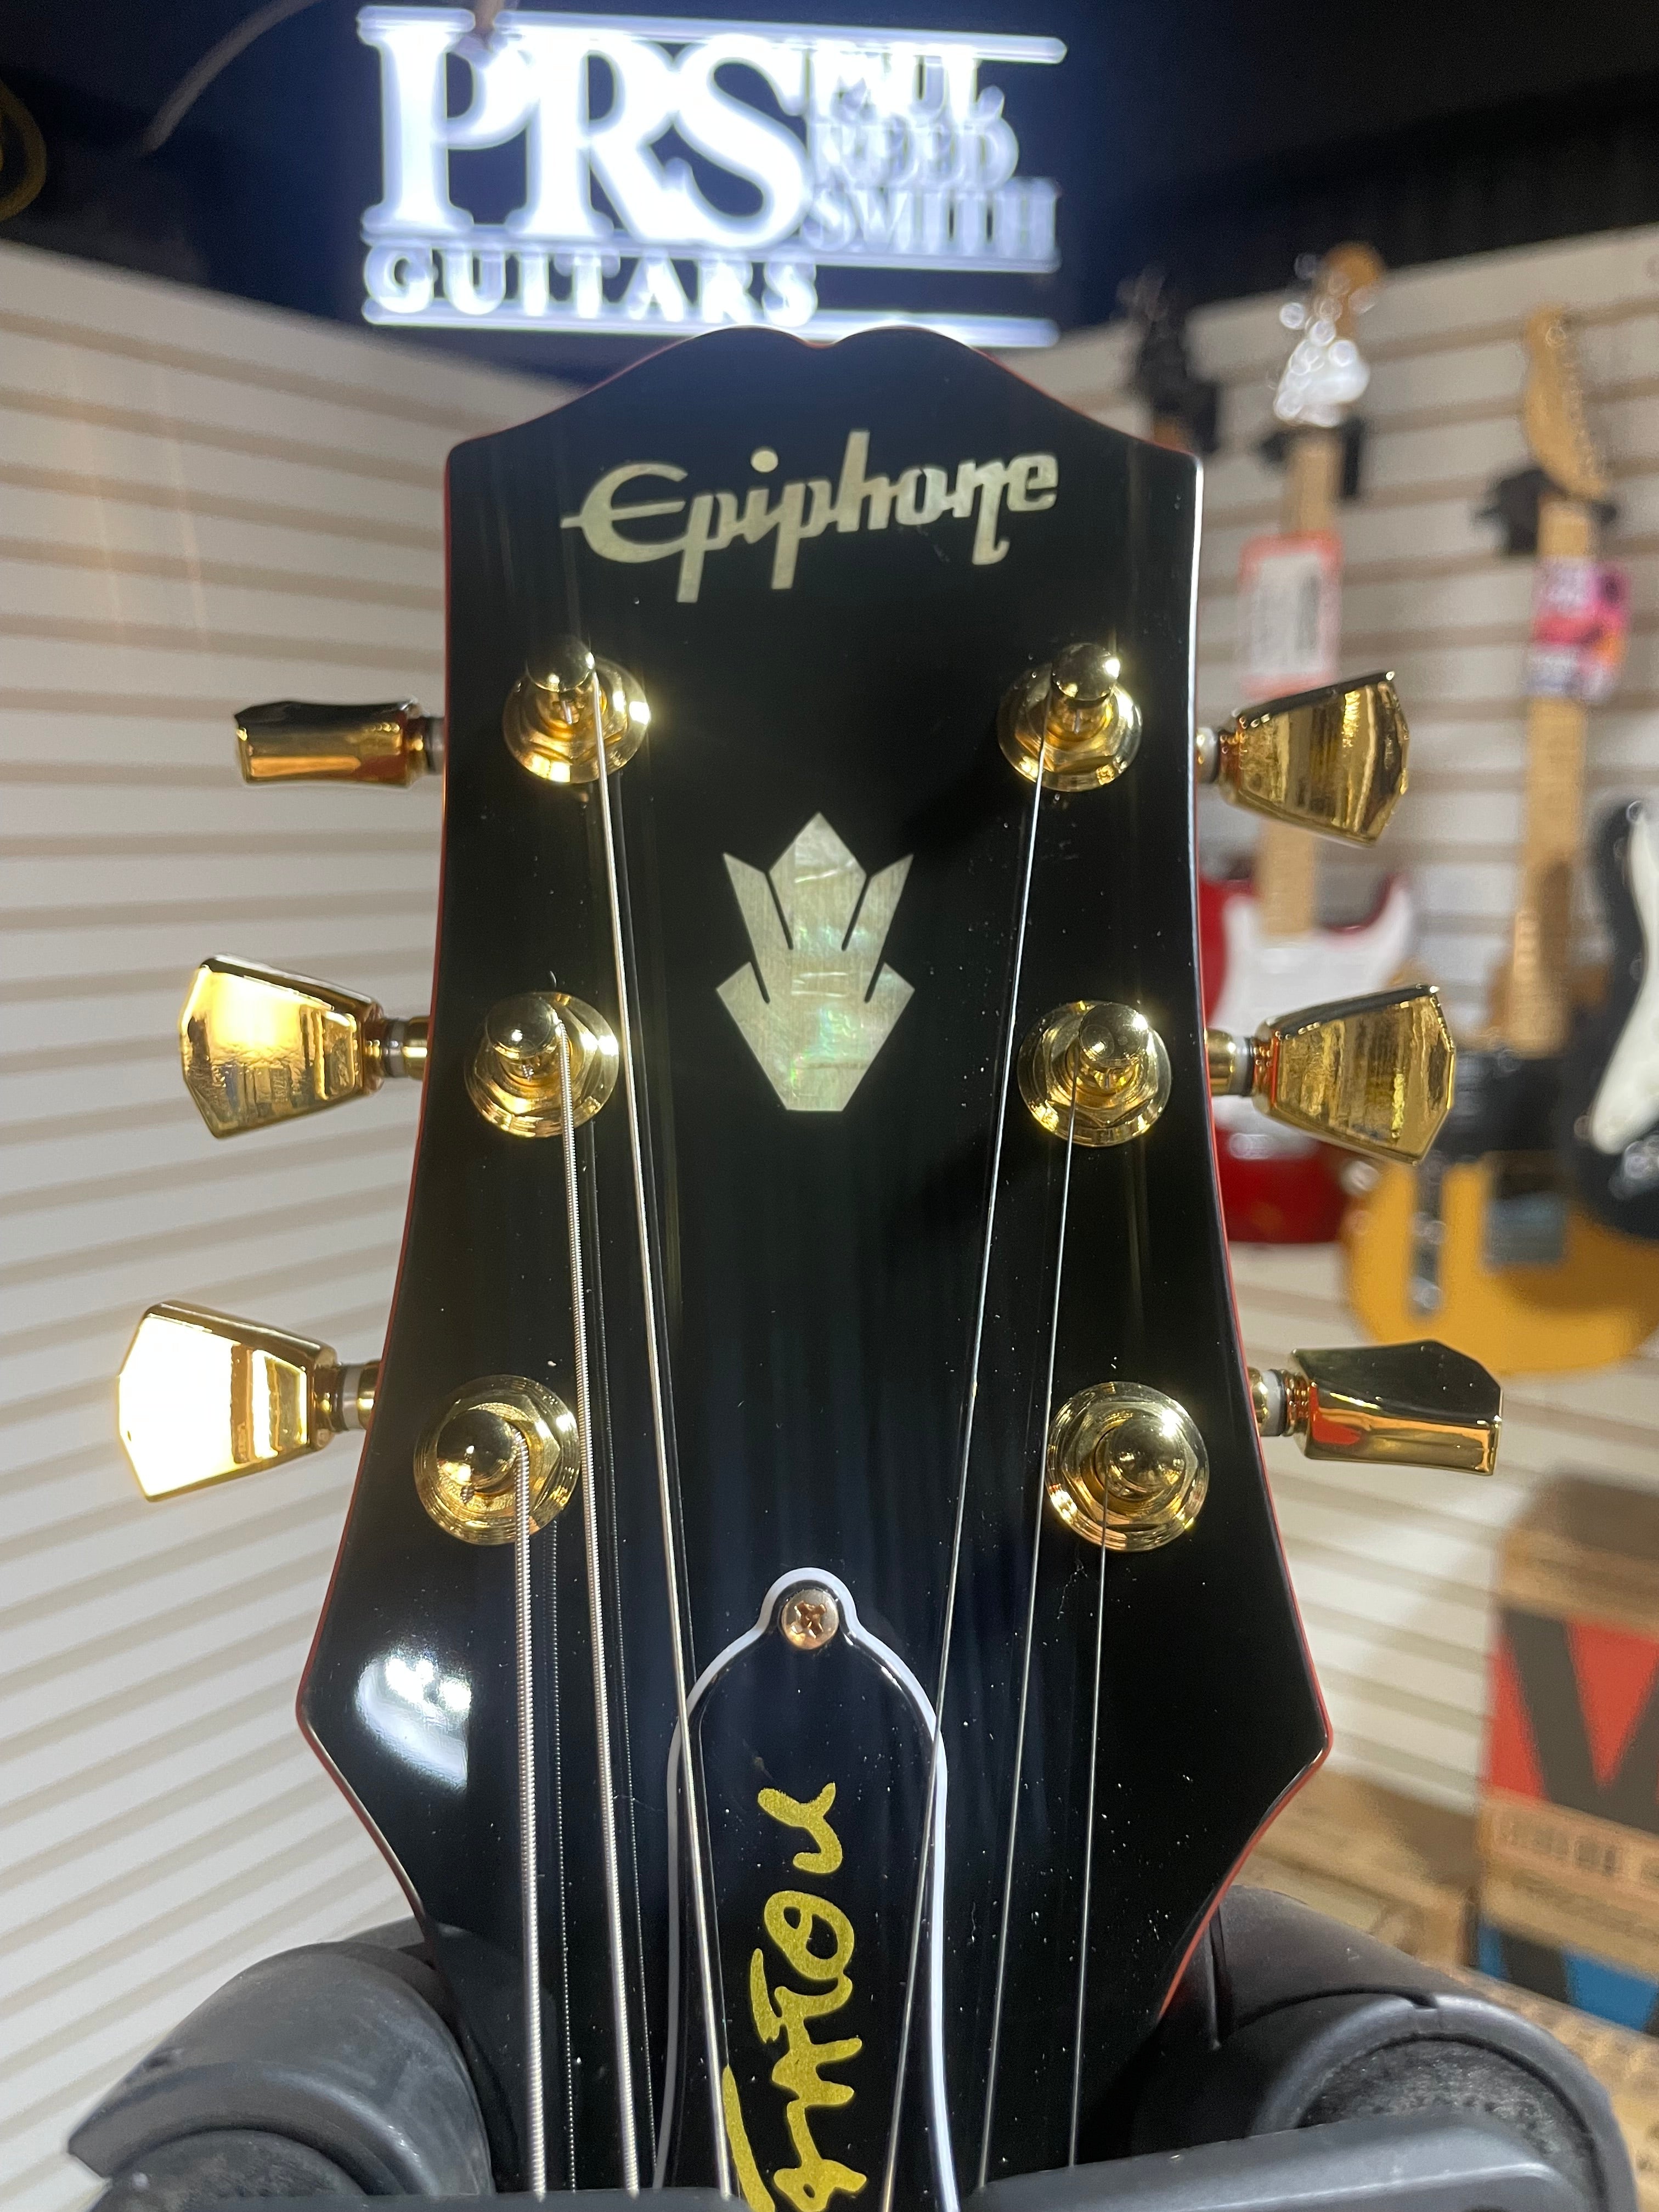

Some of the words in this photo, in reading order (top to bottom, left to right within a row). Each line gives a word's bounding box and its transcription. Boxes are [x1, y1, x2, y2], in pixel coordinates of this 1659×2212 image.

[358, 8, 811, 246] PRS
[803, 178, 1057, 256] SMITH
[364, 244, 816, 324] GUITARS
[560, 430, 1059, 603] Epiphone
